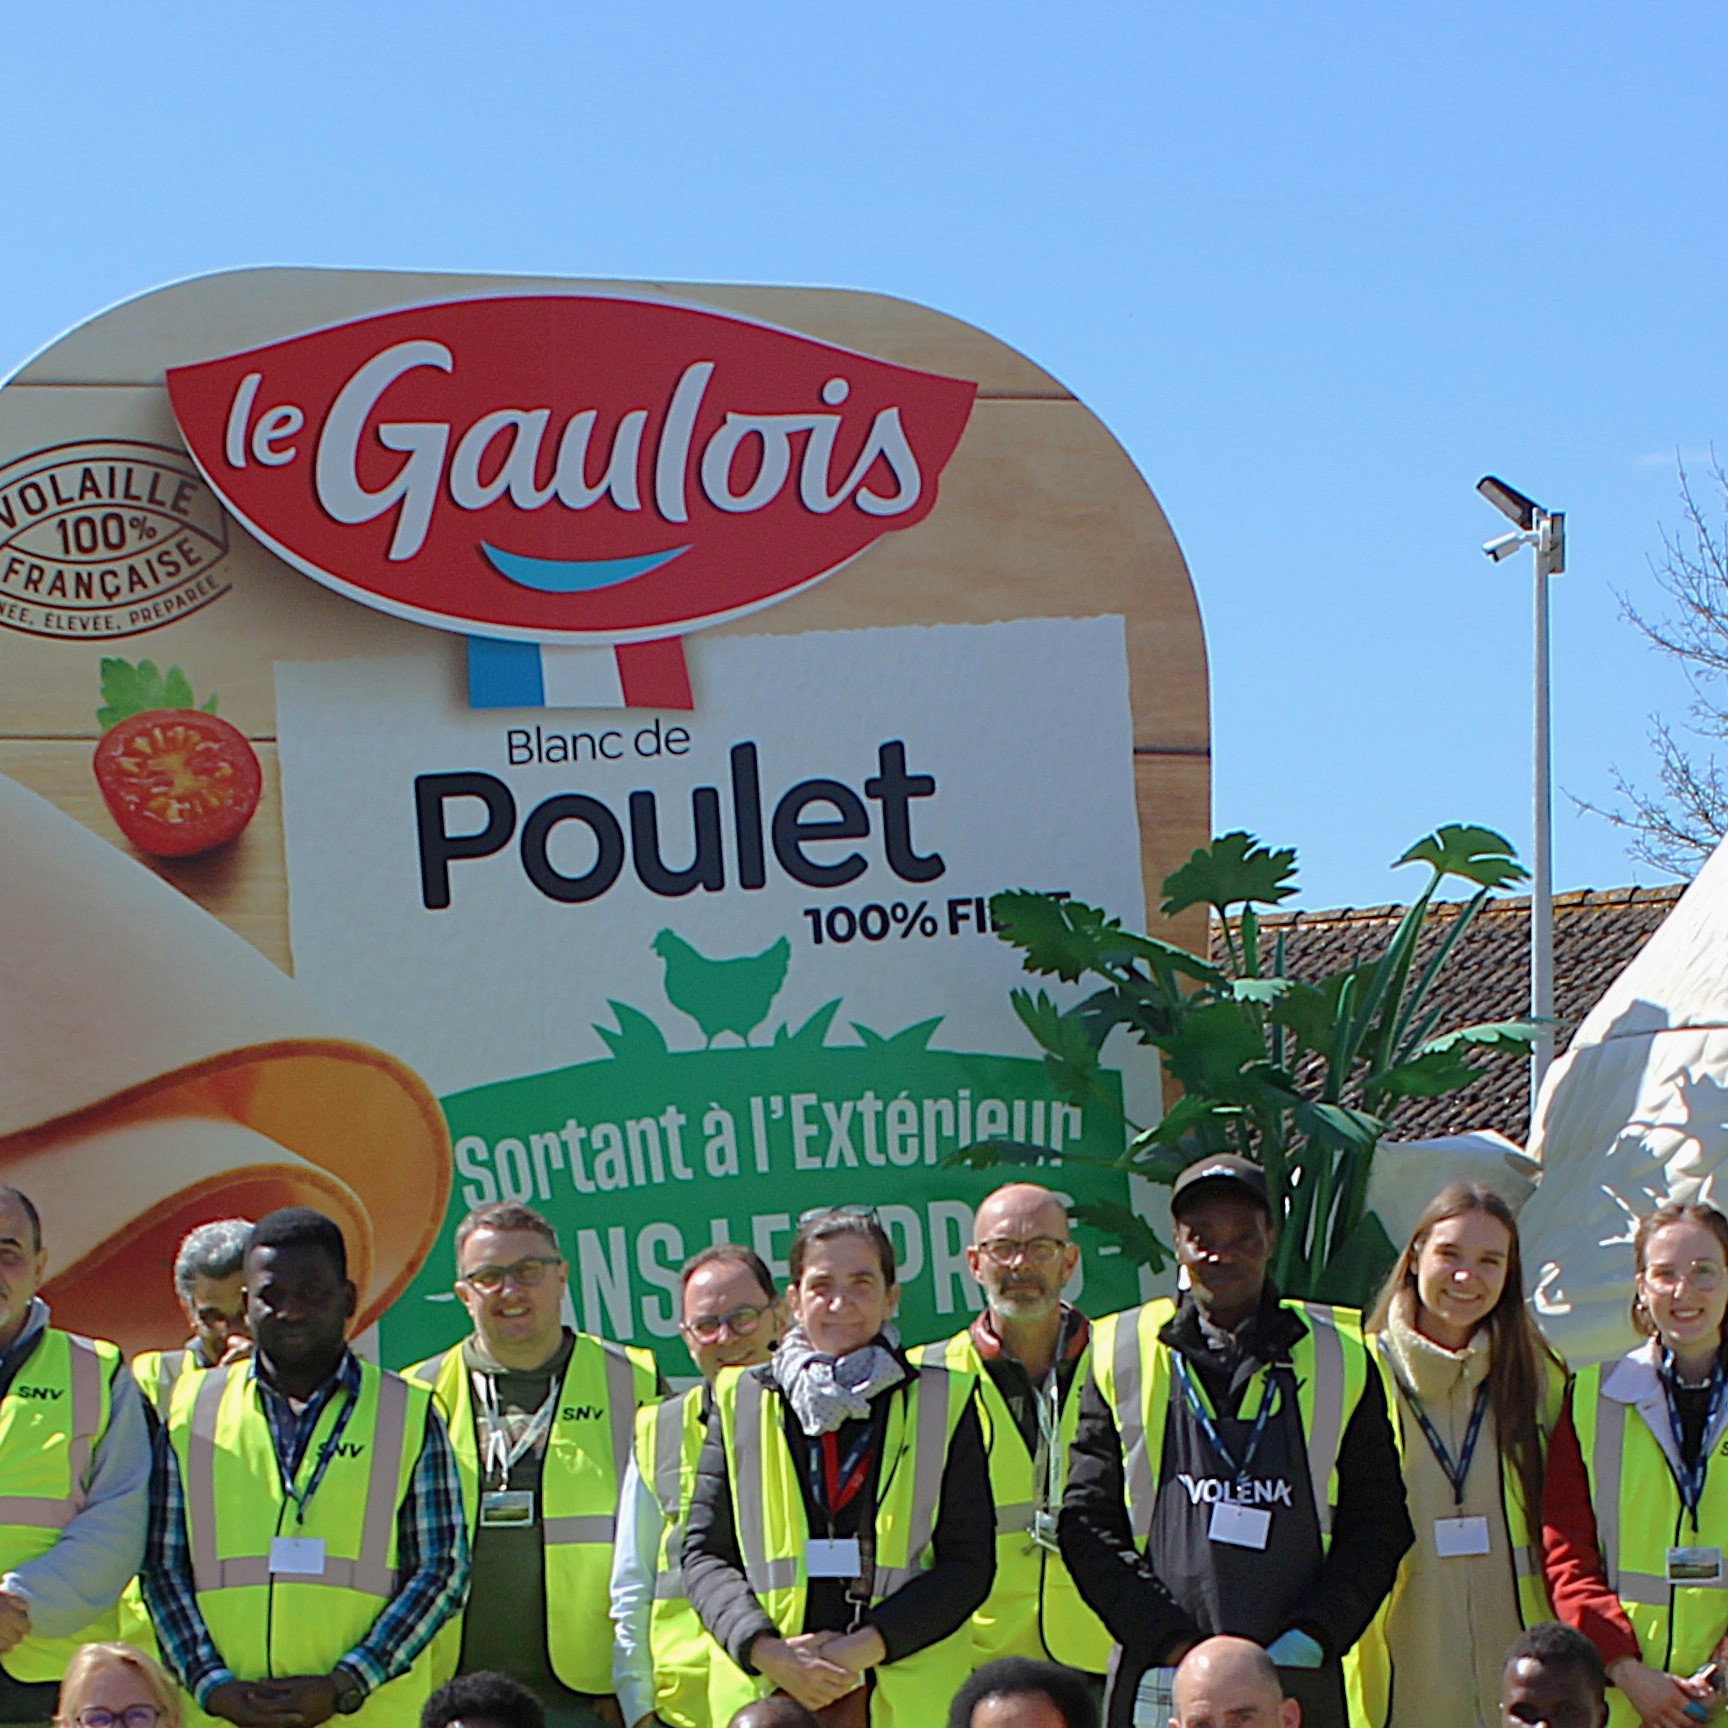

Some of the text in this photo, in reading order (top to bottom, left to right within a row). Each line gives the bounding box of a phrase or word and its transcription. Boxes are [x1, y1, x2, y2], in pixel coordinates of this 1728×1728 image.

[224, 340, 922, 560] le Gaulois
[56, 512, 158, 556] 100%
[2, 540, 203, 602] FRANÇAISE
[506, 718, 690, 765] Blanc de
[414, 740, 946, 910] Poulet
[803, 901, 938, 944] 100%
[454, 1104, 694, 1211] Sortant
[702, 1101, 740, 1177] à
[18, 1385, 65, 1401] SNV
[562, 1405, 605, 1422] SNV
